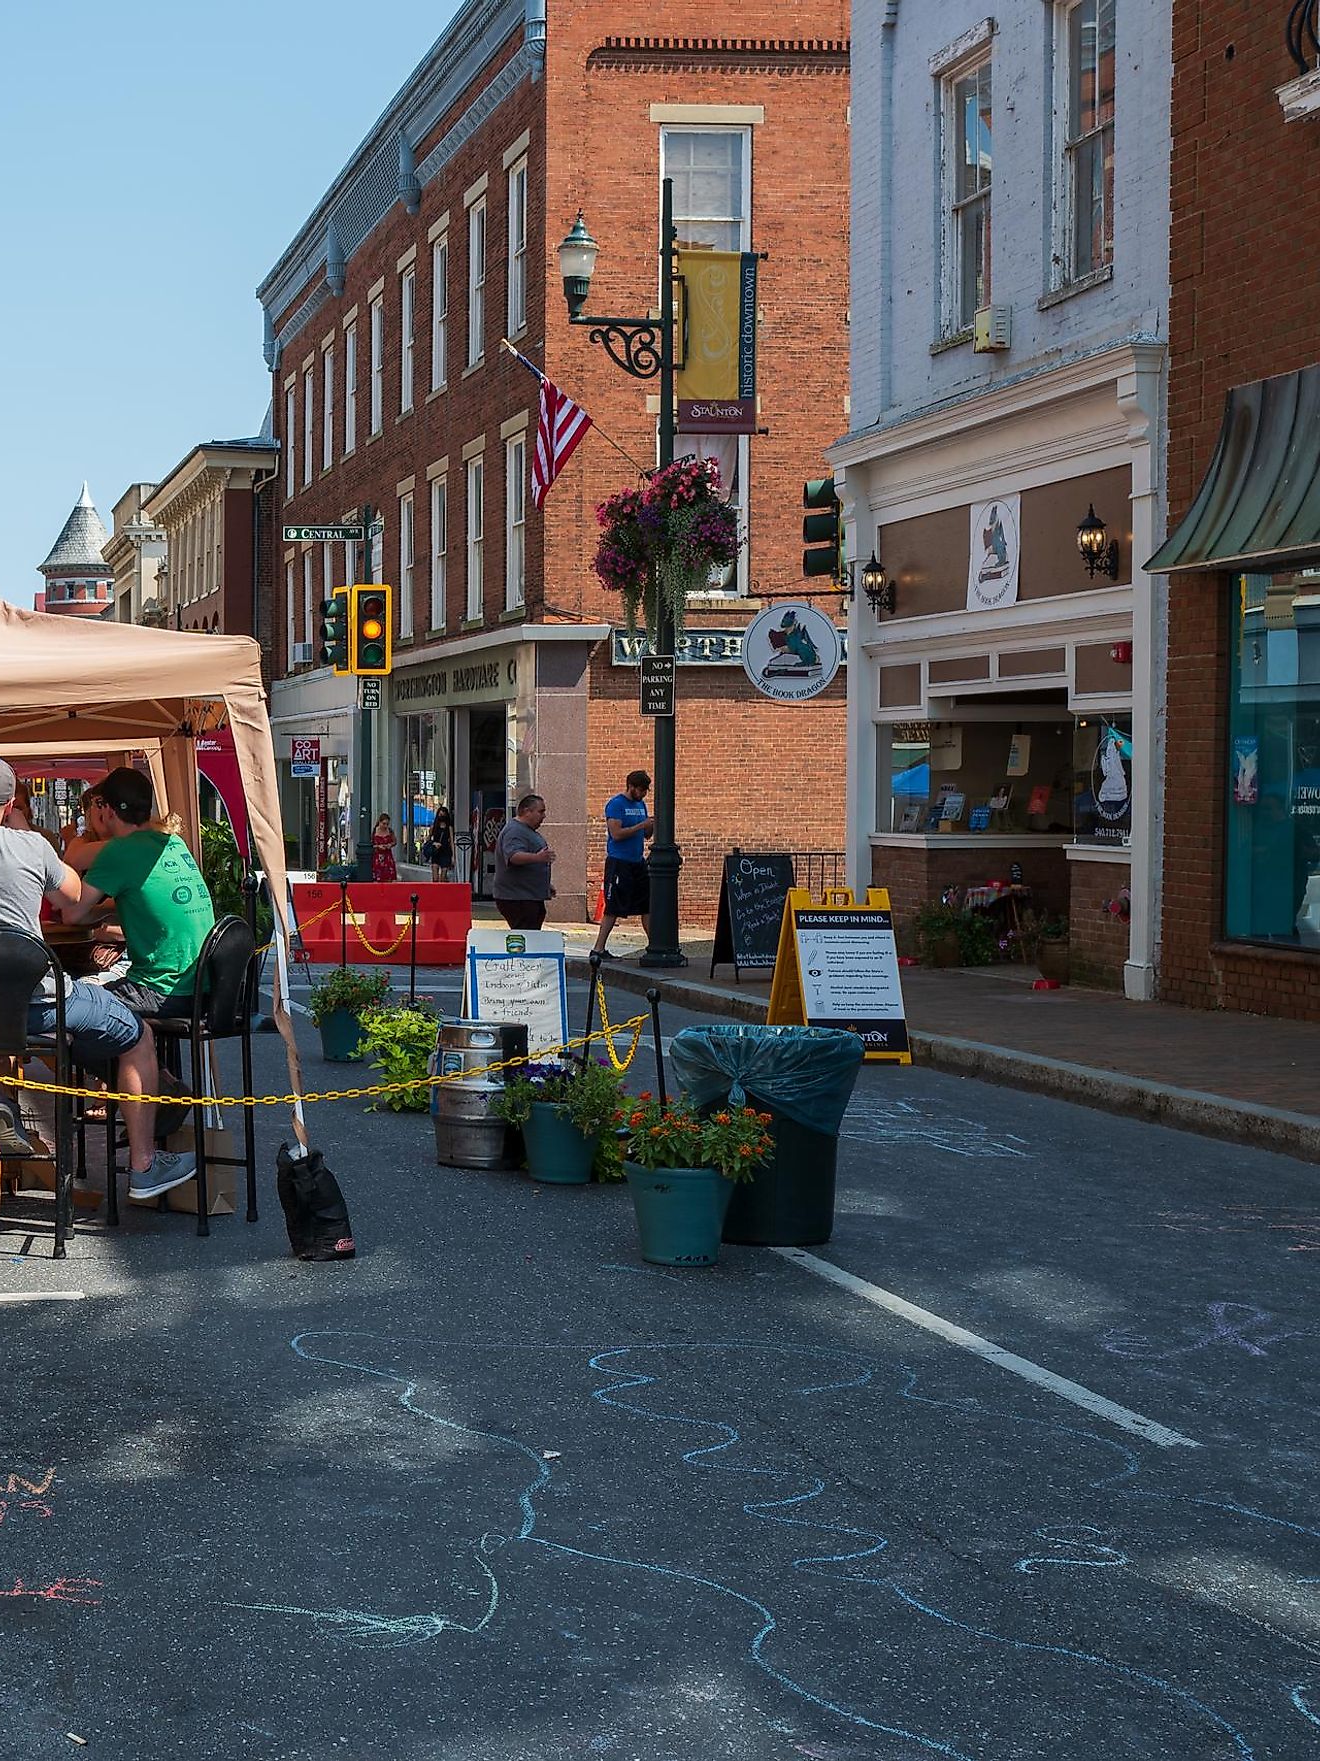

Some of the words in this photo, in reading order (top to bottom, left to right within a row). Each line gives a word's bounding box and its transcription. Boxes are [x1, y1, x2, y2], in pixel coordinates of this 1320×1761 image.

[741, 267, 755, 343] downtown
[741, 346, 754, 398] historic
[691, 404, 744, 418] STAUNTON
[301, 528, 345, 539] CENTRAL
[652, 662, 664, 670] NO
[453, 662, 500, 693] HARDWARE
[642, 675, 673, 683] PARKING
[650, 688, 665, 697] ANY
[757, 677, 773, 694] THE
[772, 686, 794, 699] BOOK
[796, 677, 827, 699] DRAGON
[648, 702, 667, 710] TIME
[295, 740, 312, 749] CO
[293, 748, 319, 761] ART
[740, 858, 776, 880] Open
[303, 872, 316, 880] 156
[307, 889, 323, 899] 156
[799, 915, 829, 923] PLEASE
[829, 915, 849, 923] KEEP
[850, 915, 860, 923] IN
[484, 958, 514, 972] Craft
[519, 959, 542, 972] Beer
[482, 996, 505, 1007] Bring
[860, 1031, 889, 1042] NTON
